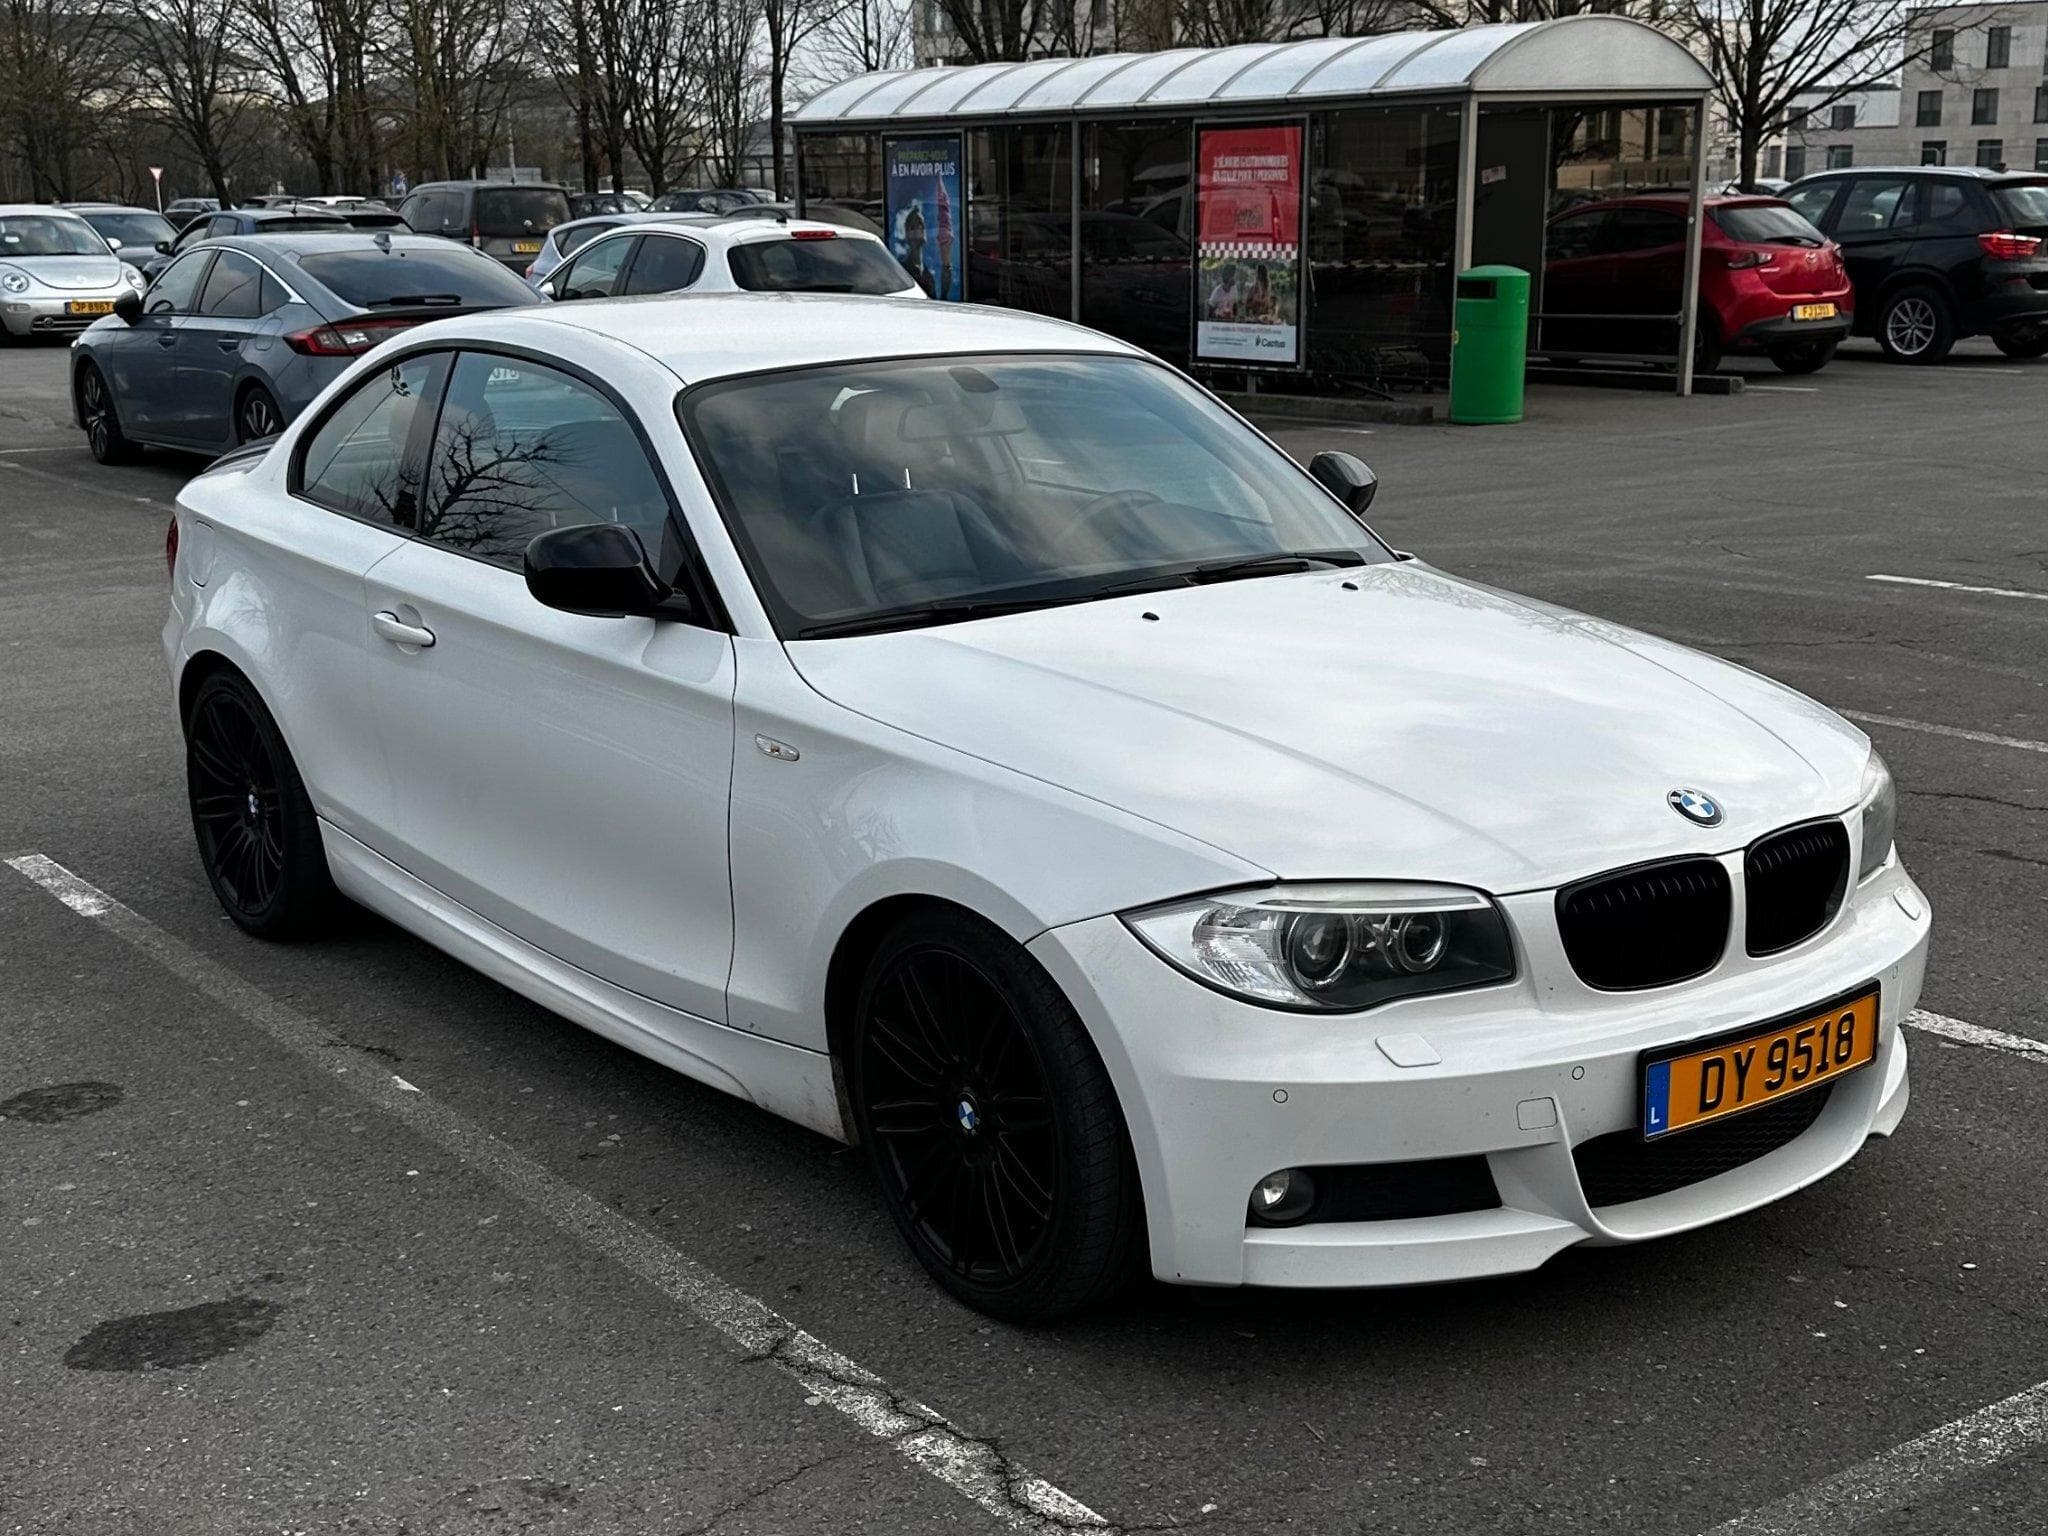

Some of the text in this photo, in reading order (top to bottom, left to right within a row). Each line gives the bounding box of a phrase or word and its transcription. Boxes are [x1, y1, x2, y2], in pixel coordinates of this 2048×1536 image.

[899, 163, 909, 176] EN
[911, 162, 933, 176] AVOIR
[934, 161, 955, 176] PLUS
[1261, 338, 1286, 348] Cactus
[1699, 1010, 1855, 1114] DY 9518
[1650, 1106, 1660, 1124] L
